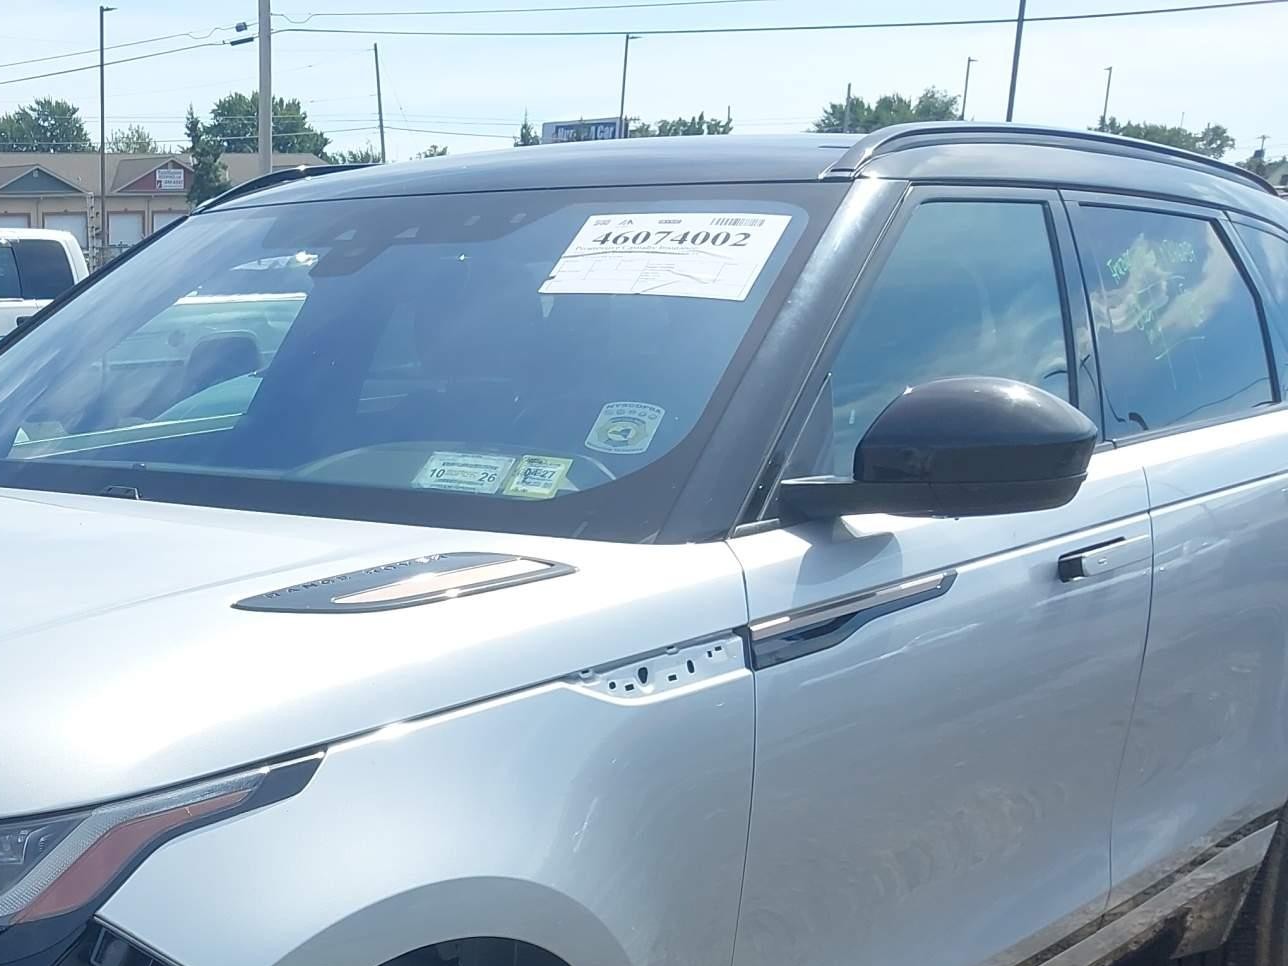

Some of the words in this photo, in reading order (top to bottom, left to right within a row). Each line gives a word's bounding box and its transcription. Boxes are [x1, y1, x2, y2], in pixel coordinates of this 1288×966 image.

[593, 231, 752, 248] 46074002
[429, 468, 445, 479] 10
[478, 472, 497, 483] 26
[364, 552, 449, 575] ROVR
